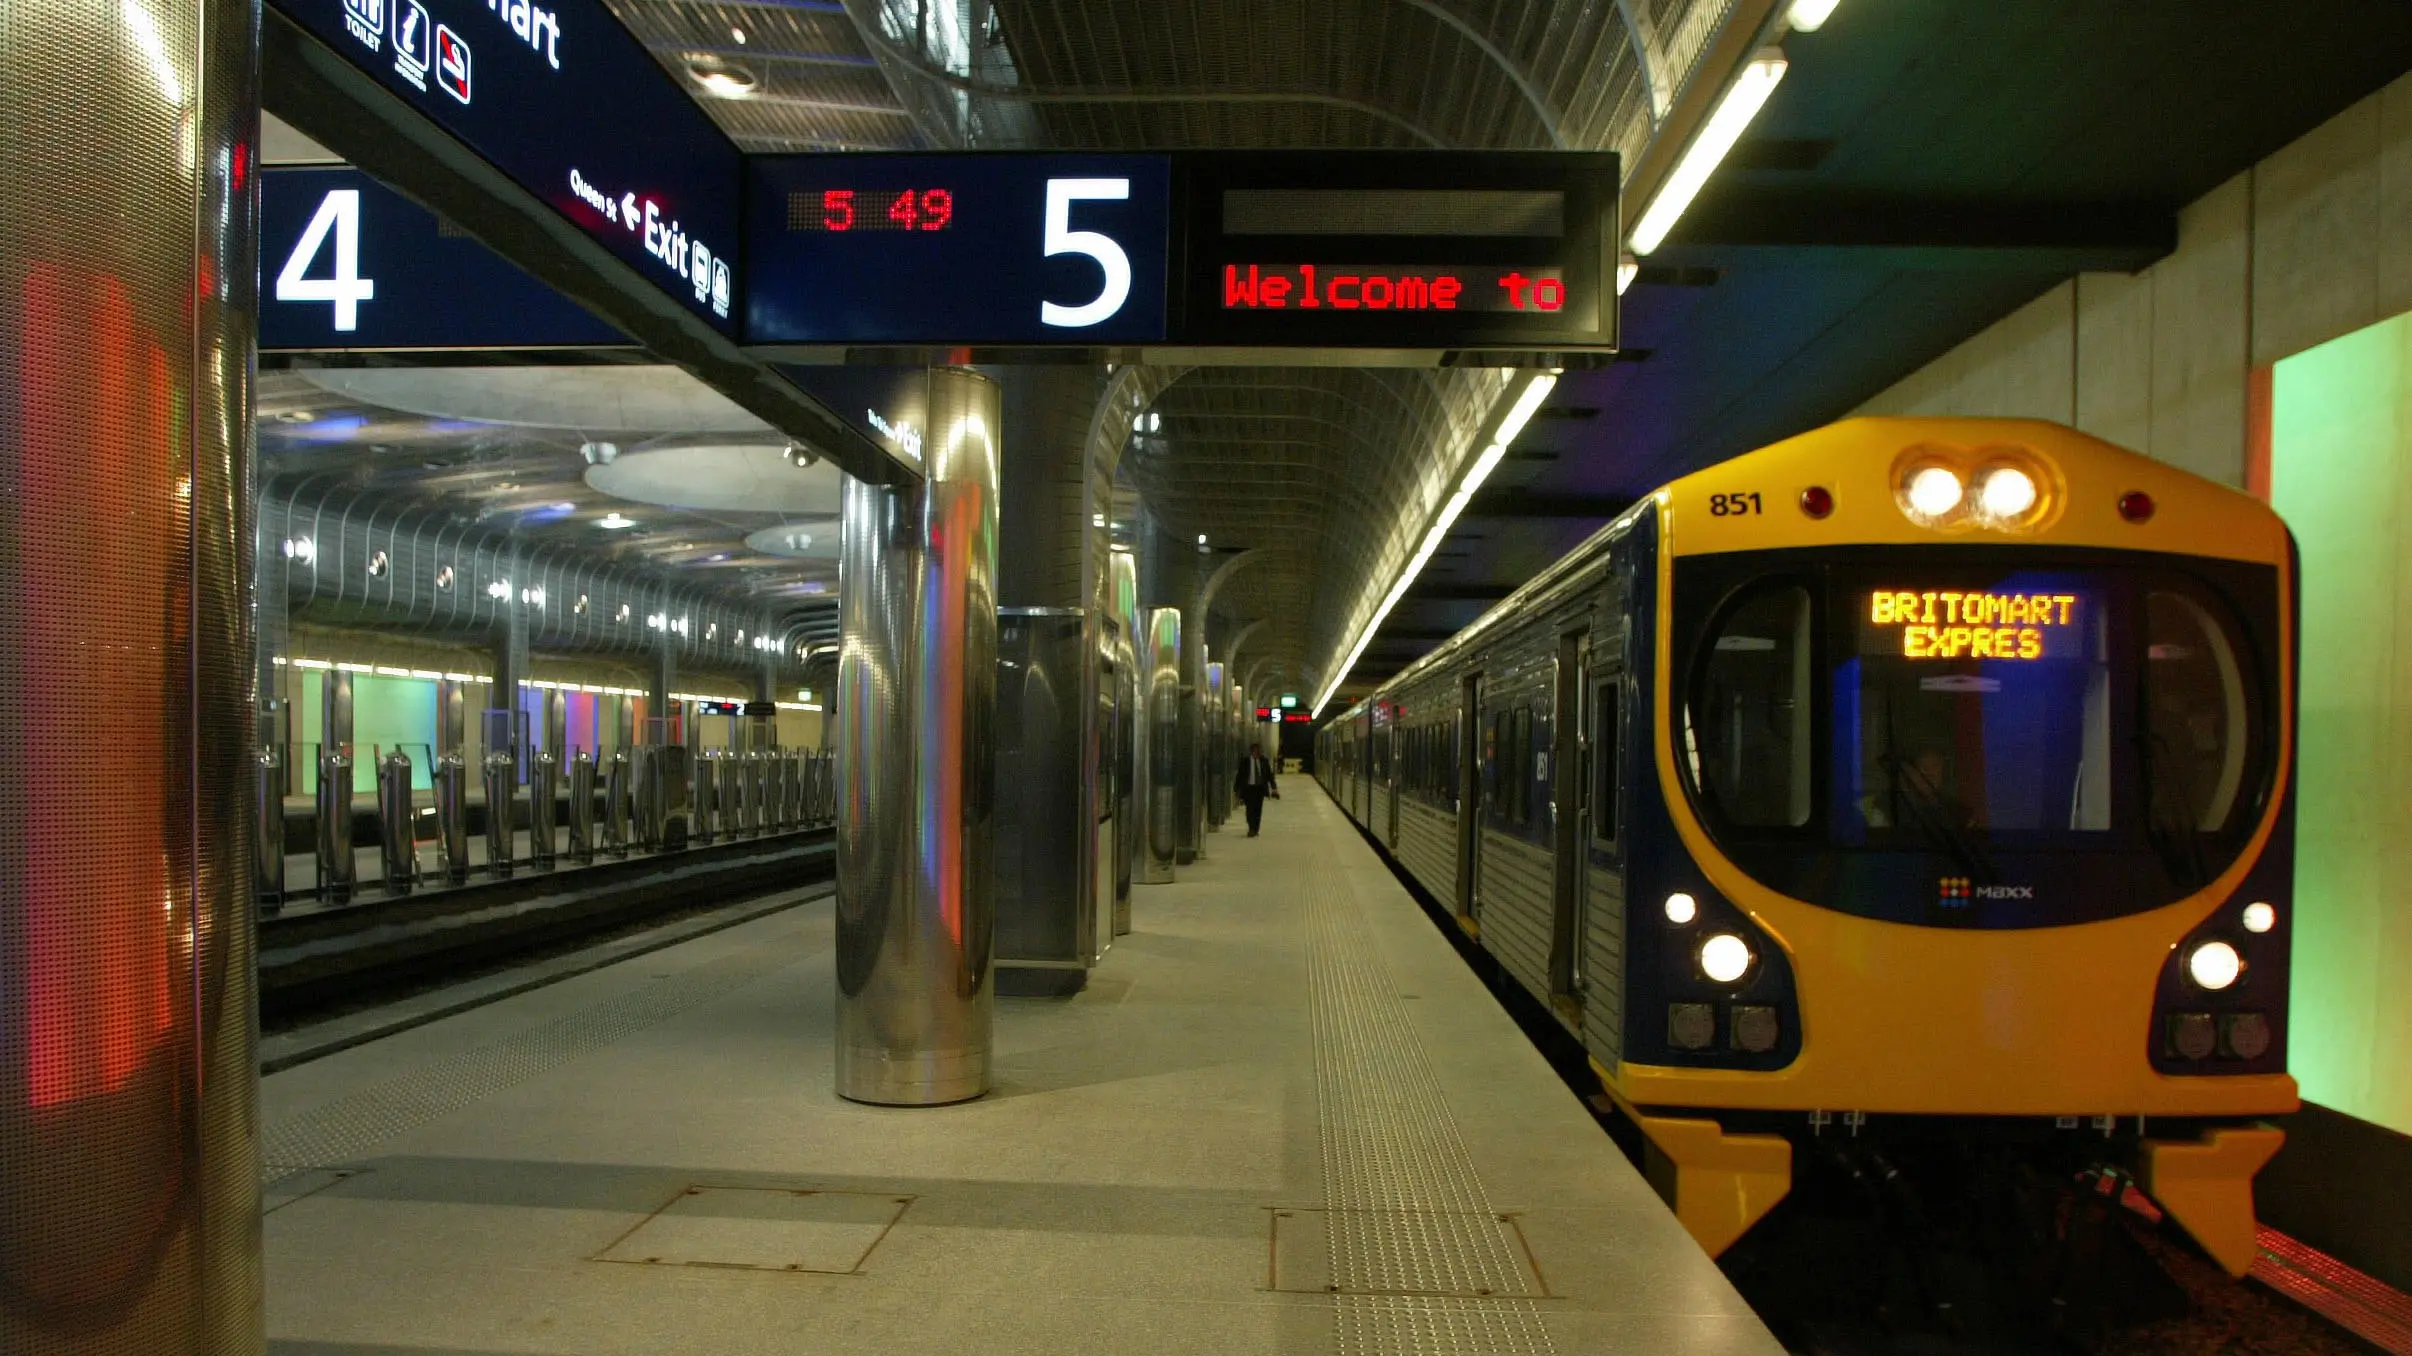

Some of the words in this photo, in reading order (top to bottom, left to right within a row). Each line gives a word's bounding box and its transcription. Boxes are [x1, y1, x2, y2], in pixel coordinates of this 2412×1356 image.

[344, 13, 381, 52] TOILET
[487, 0, 561, 69] art
[570, 169, 605, 213] Queen
[645, 200, 689, 278] Exit
[276, 189, 374, 332] 4
[1041, 178, 1132, 328] 5
[1225, 264, 1461, 310] Welcome
[1498, 272, 1565, 312] to
[1710, 492, 1763, 517] 851
[1872, 592, 2075, 625] BRITOMART
[1904, 626, 2041, 658] EXPRES
